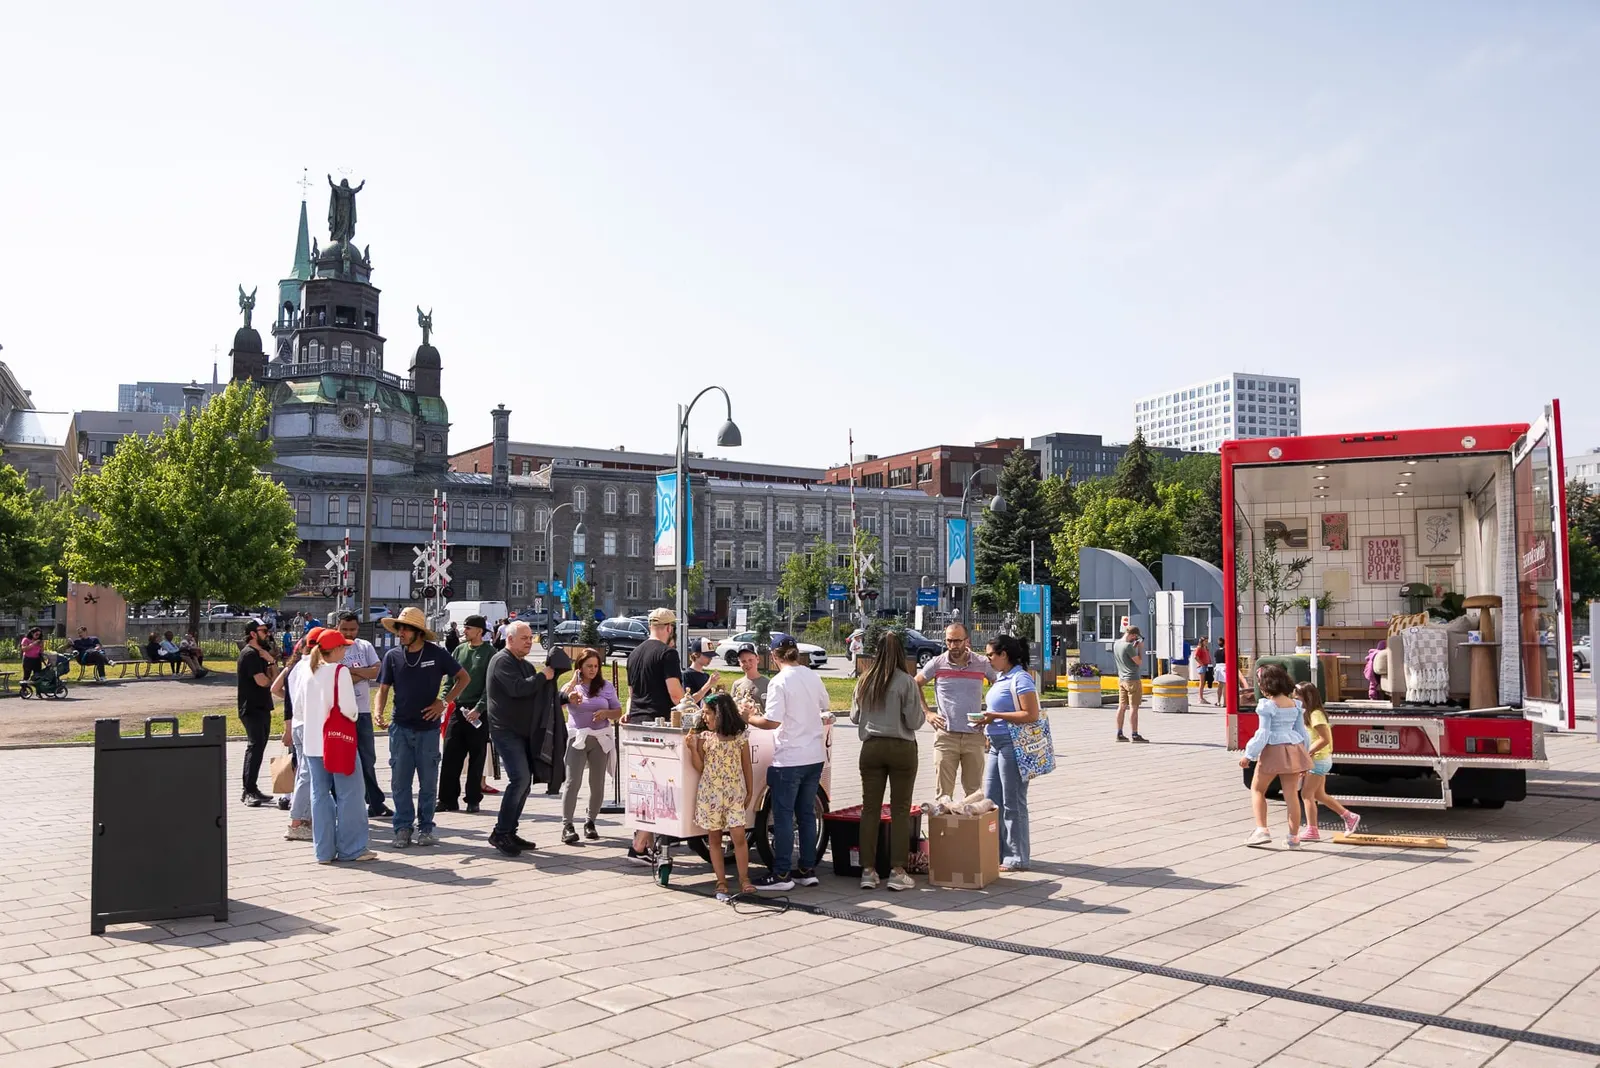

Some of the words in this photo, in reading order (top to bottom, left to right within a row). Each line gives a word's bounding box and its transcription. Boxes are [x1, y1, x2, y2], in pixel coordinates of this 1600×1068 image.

[1368, 539, 1399, 549] SLOW
[1368, 547, 1399, 557] DOWN
[1368, 555, 1402, 565] YOU'RE
[1368, 563, 1401, 572] DOING
[1367, 571, 1400, 580] FINE
